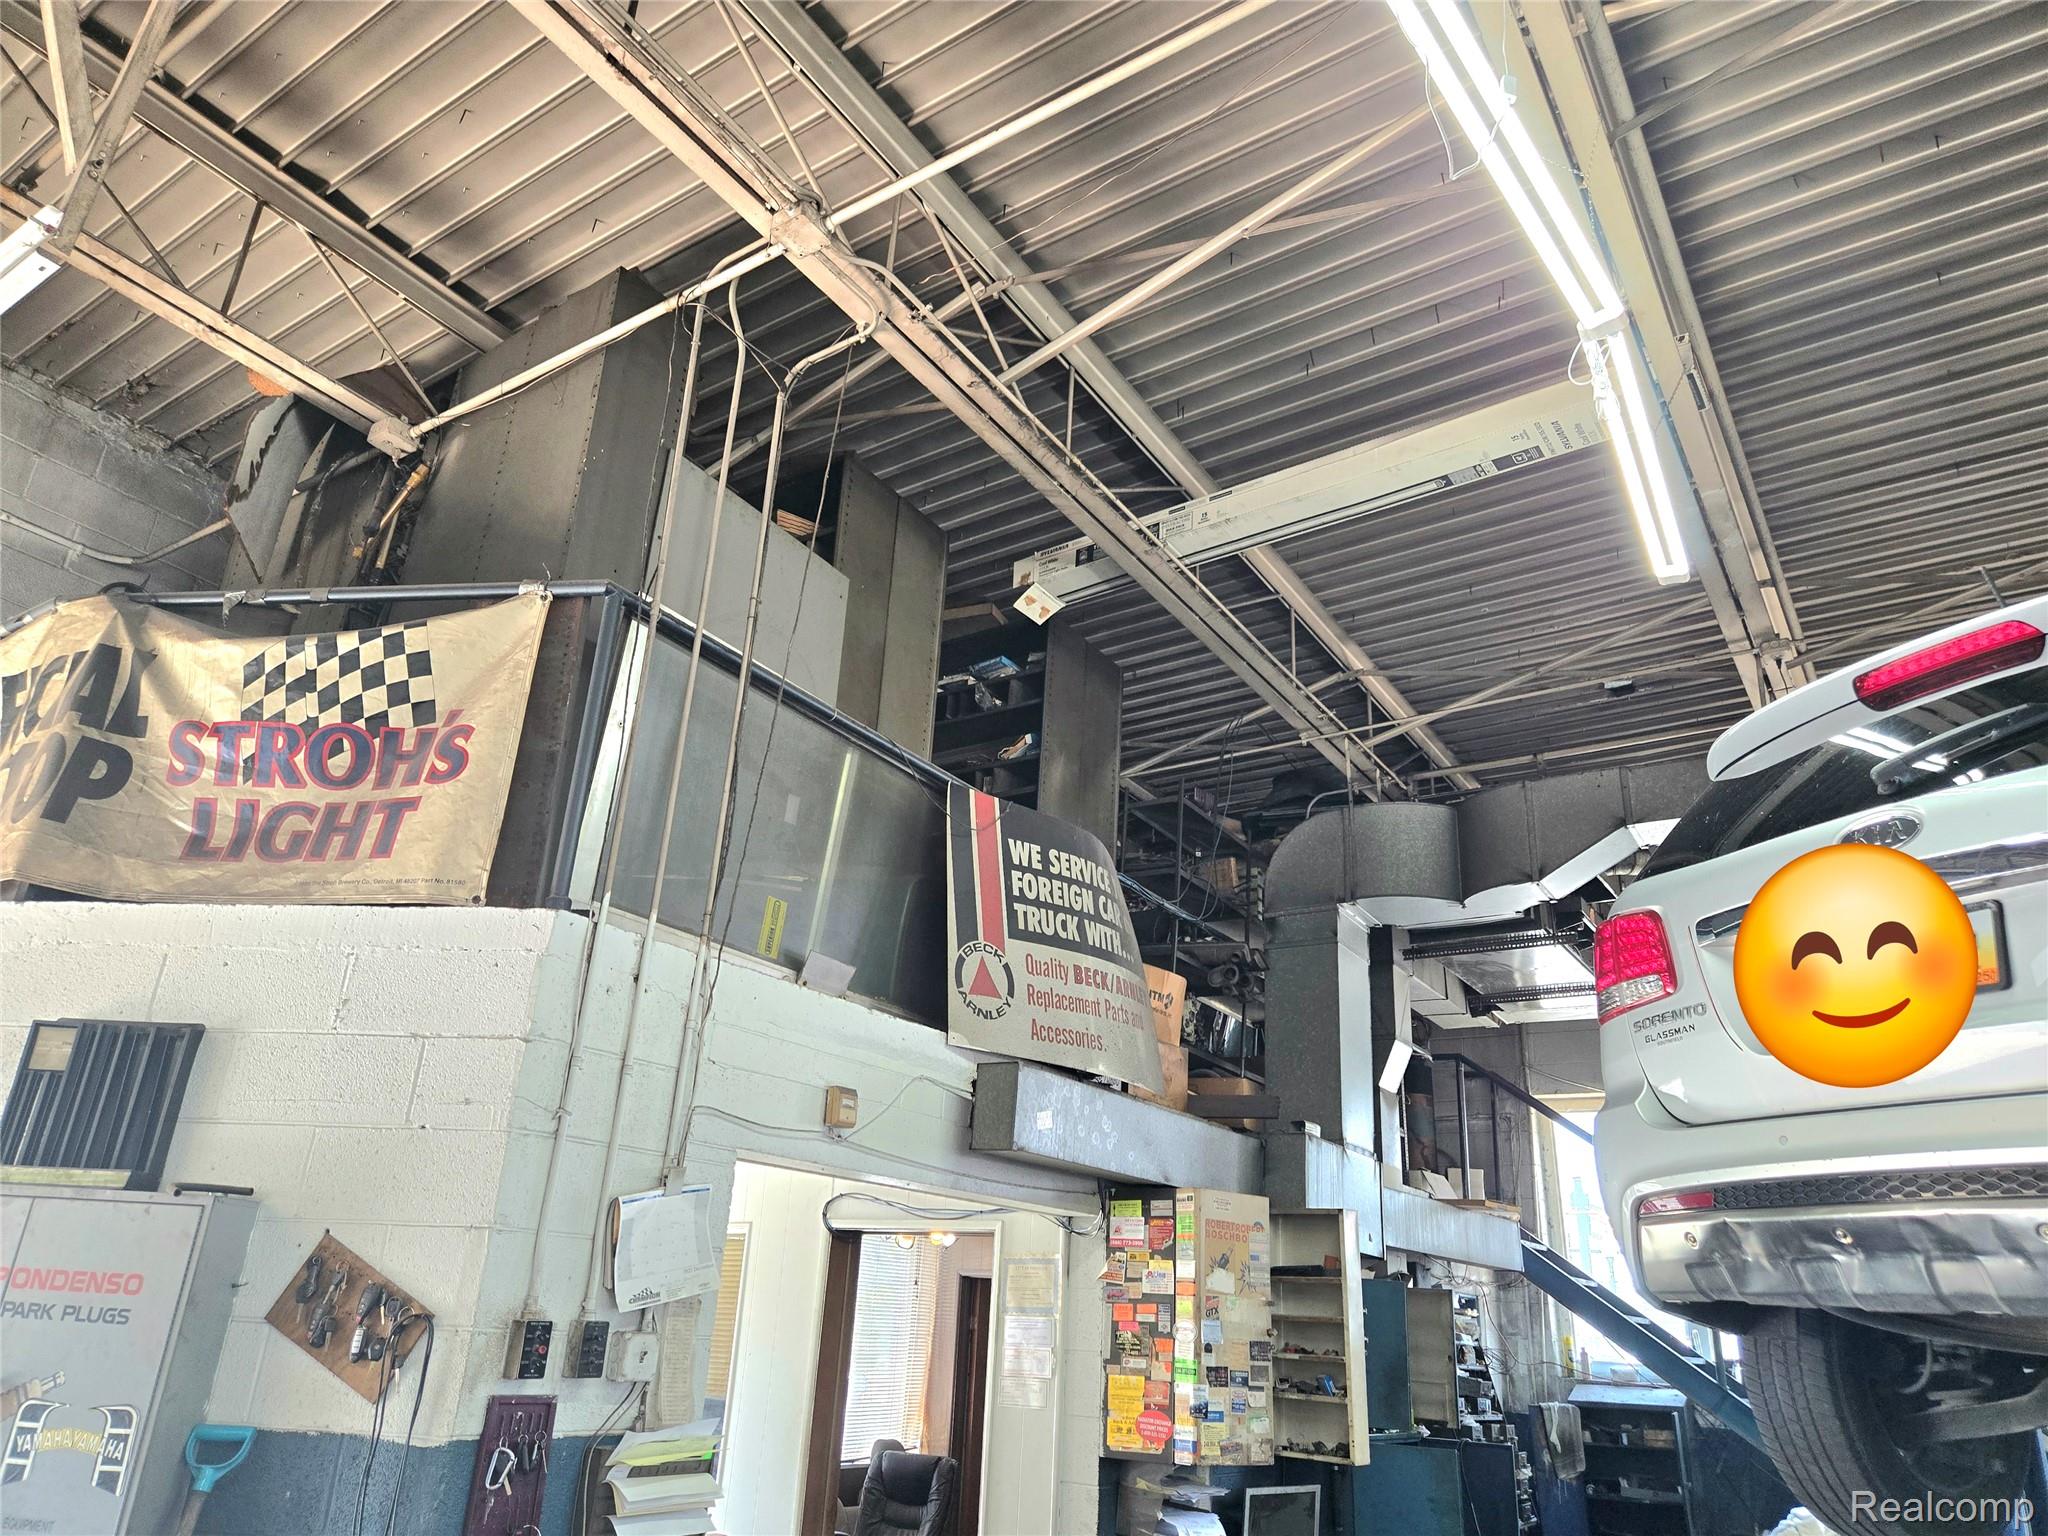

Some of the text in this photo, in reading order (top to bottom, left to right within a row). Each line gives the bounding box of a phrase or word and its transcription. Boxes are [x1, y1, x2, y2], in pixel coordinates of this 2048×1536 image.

[166, 709, 475, 791] STROH'S
[179, 796, 422, 864] LIGHT
[1008, 838, 1042, 870] WE
[1049, 848, 1112, 894] SERVICE
[1011, 870, 1094, 915] FOREIGN
[1099, 895, 1122, 929] CAR
[1013, 903, 1080, 942] TRUCK
[963, 942, 1005, 963] BECK
[1025, 953, 1069, 985] Quality
[958, 990, 1012, 1020] ARNLEY
[1027, 984, 1101, 1018] Replacement
[1104, 998, 1130, 1025] Parts
[1633, 1002, 1707, 1033] SORENTO
[1031, 1018, 1107, 1052] Accessories.
[1644, 1024, 1696, 1044] GLASSMAN
[60, 1304, 131, 1325] PLUGS
